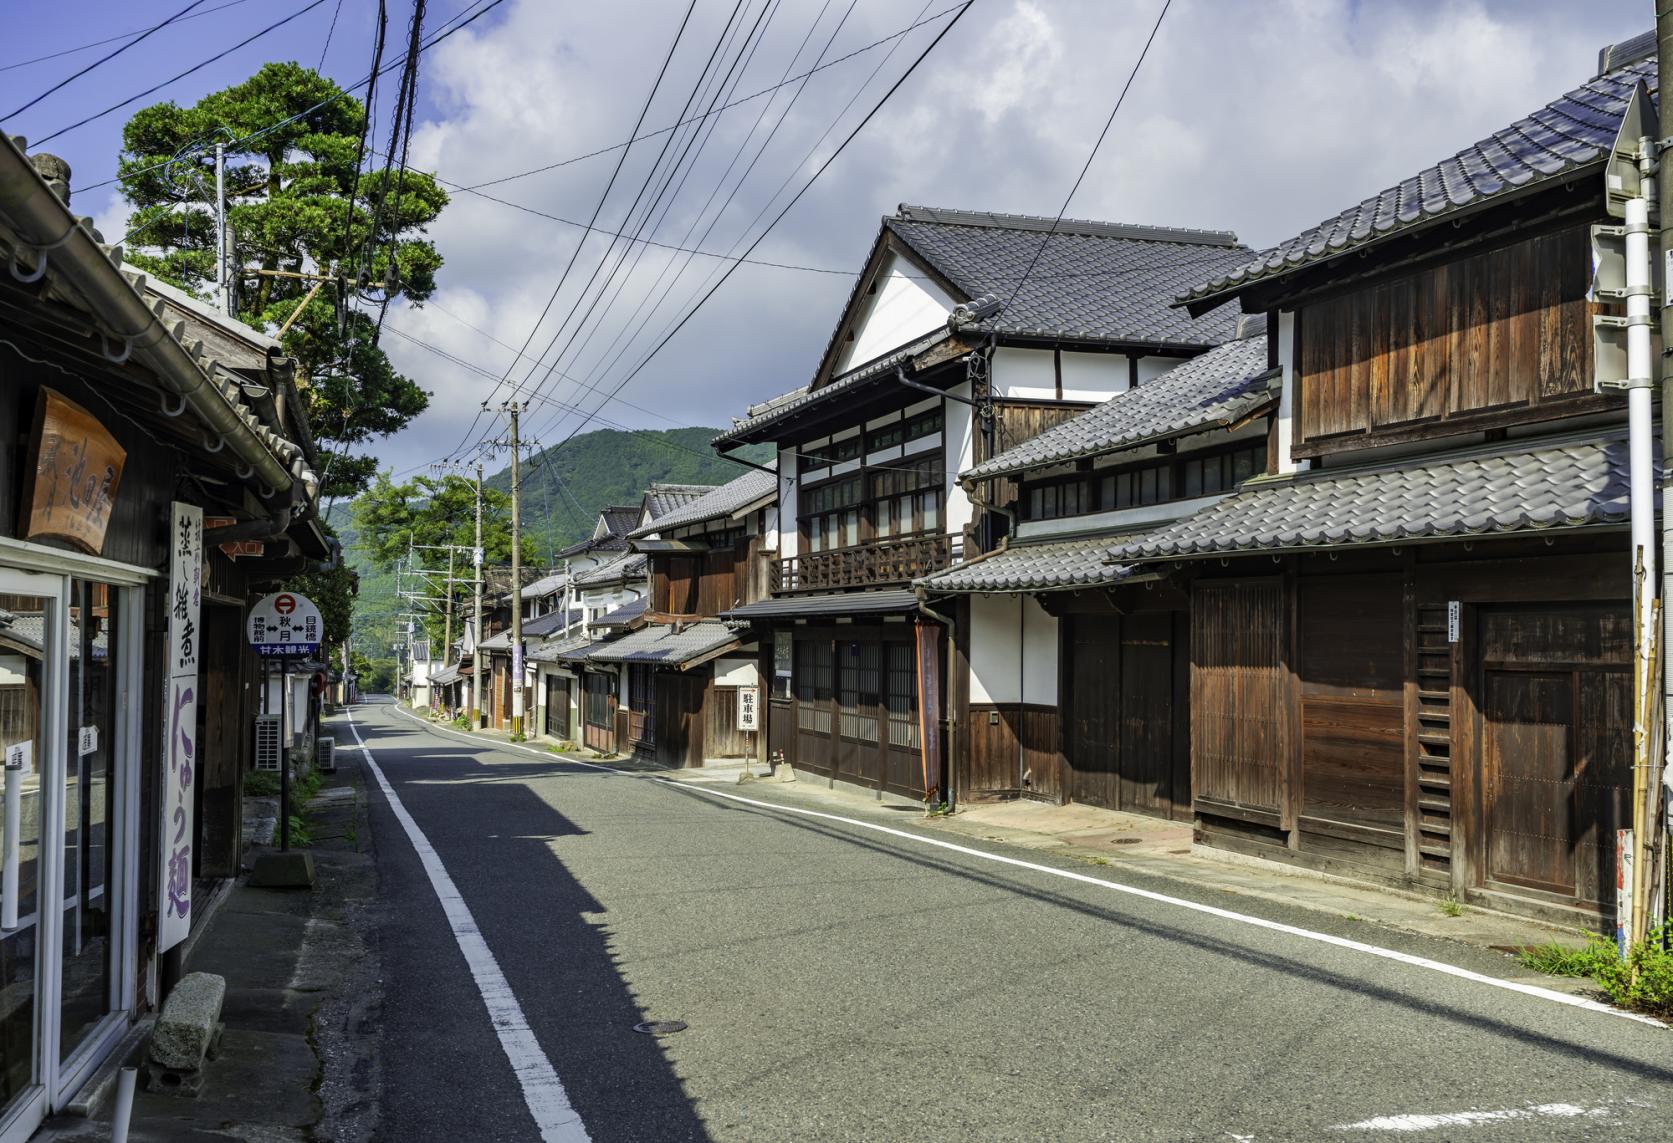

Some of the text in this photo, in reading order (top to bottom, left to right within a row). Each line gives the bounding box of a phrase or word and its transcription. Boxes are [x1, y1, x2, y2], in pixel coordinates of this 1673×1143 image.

[230, 541, 257, 553] 入口
[173, 515, 195, 669] 蒸し雑煮
[279, 616, 291, 641] 秋月
[304, 615, 317, 641] 目鏡橋
[259, 645, 310, 655] 甘木観光
[743, 693, 754, 725] 駐車場
[167, 683, 194, 921] にゅう麺
